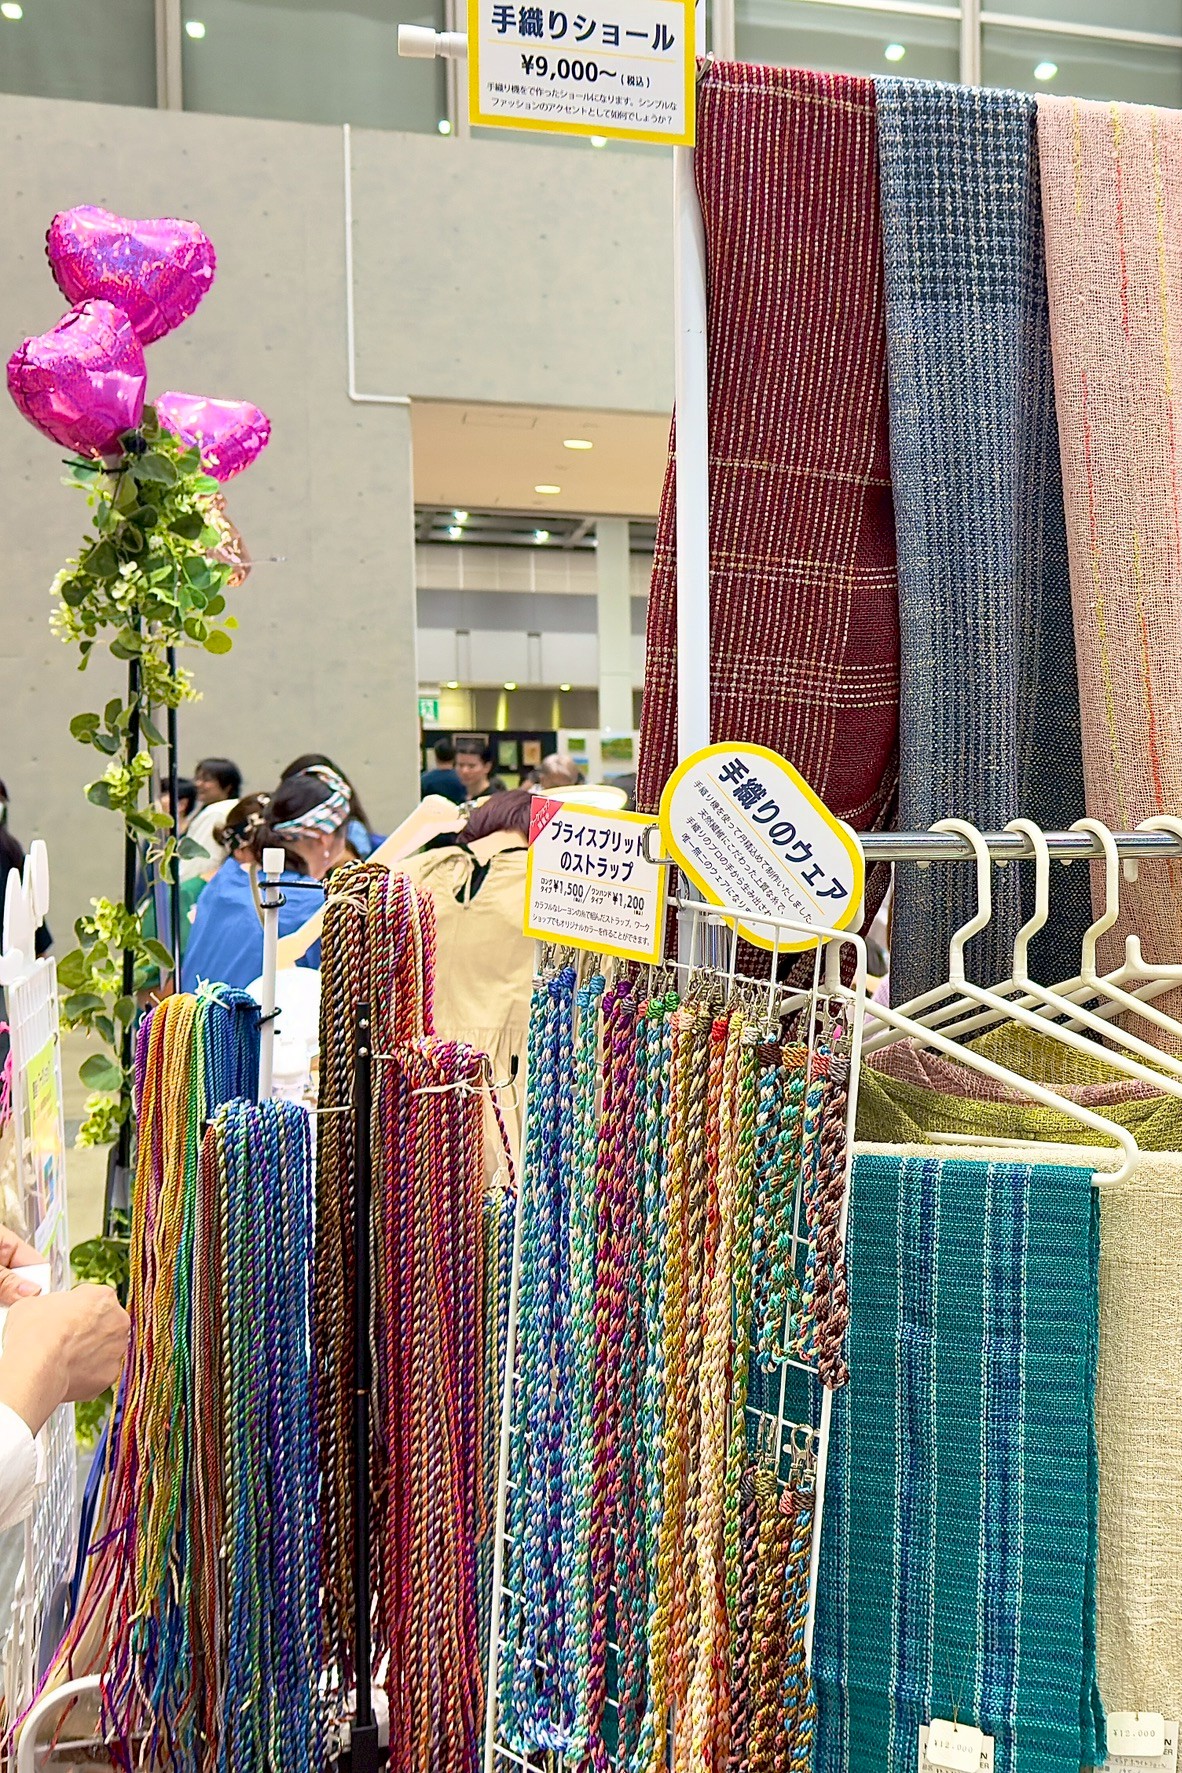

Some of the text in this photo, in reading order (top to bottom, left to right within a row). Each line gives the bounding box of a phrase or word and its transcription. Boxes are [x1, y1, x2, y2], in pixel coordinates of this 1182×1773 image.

[491, 4, 675, 52] 手織りショール
[551, 820, 644, 857] プライスプリット
[718, 757, 849, 900] 手織りのウェア
[560, 851, 634, 882] のストラップ
[686, 816, 773, 917] 手織りのプロの手から生み出され
[553, 879, 584, 898] ¥1,500
[612, 892, 645, 911] ¥1,200
